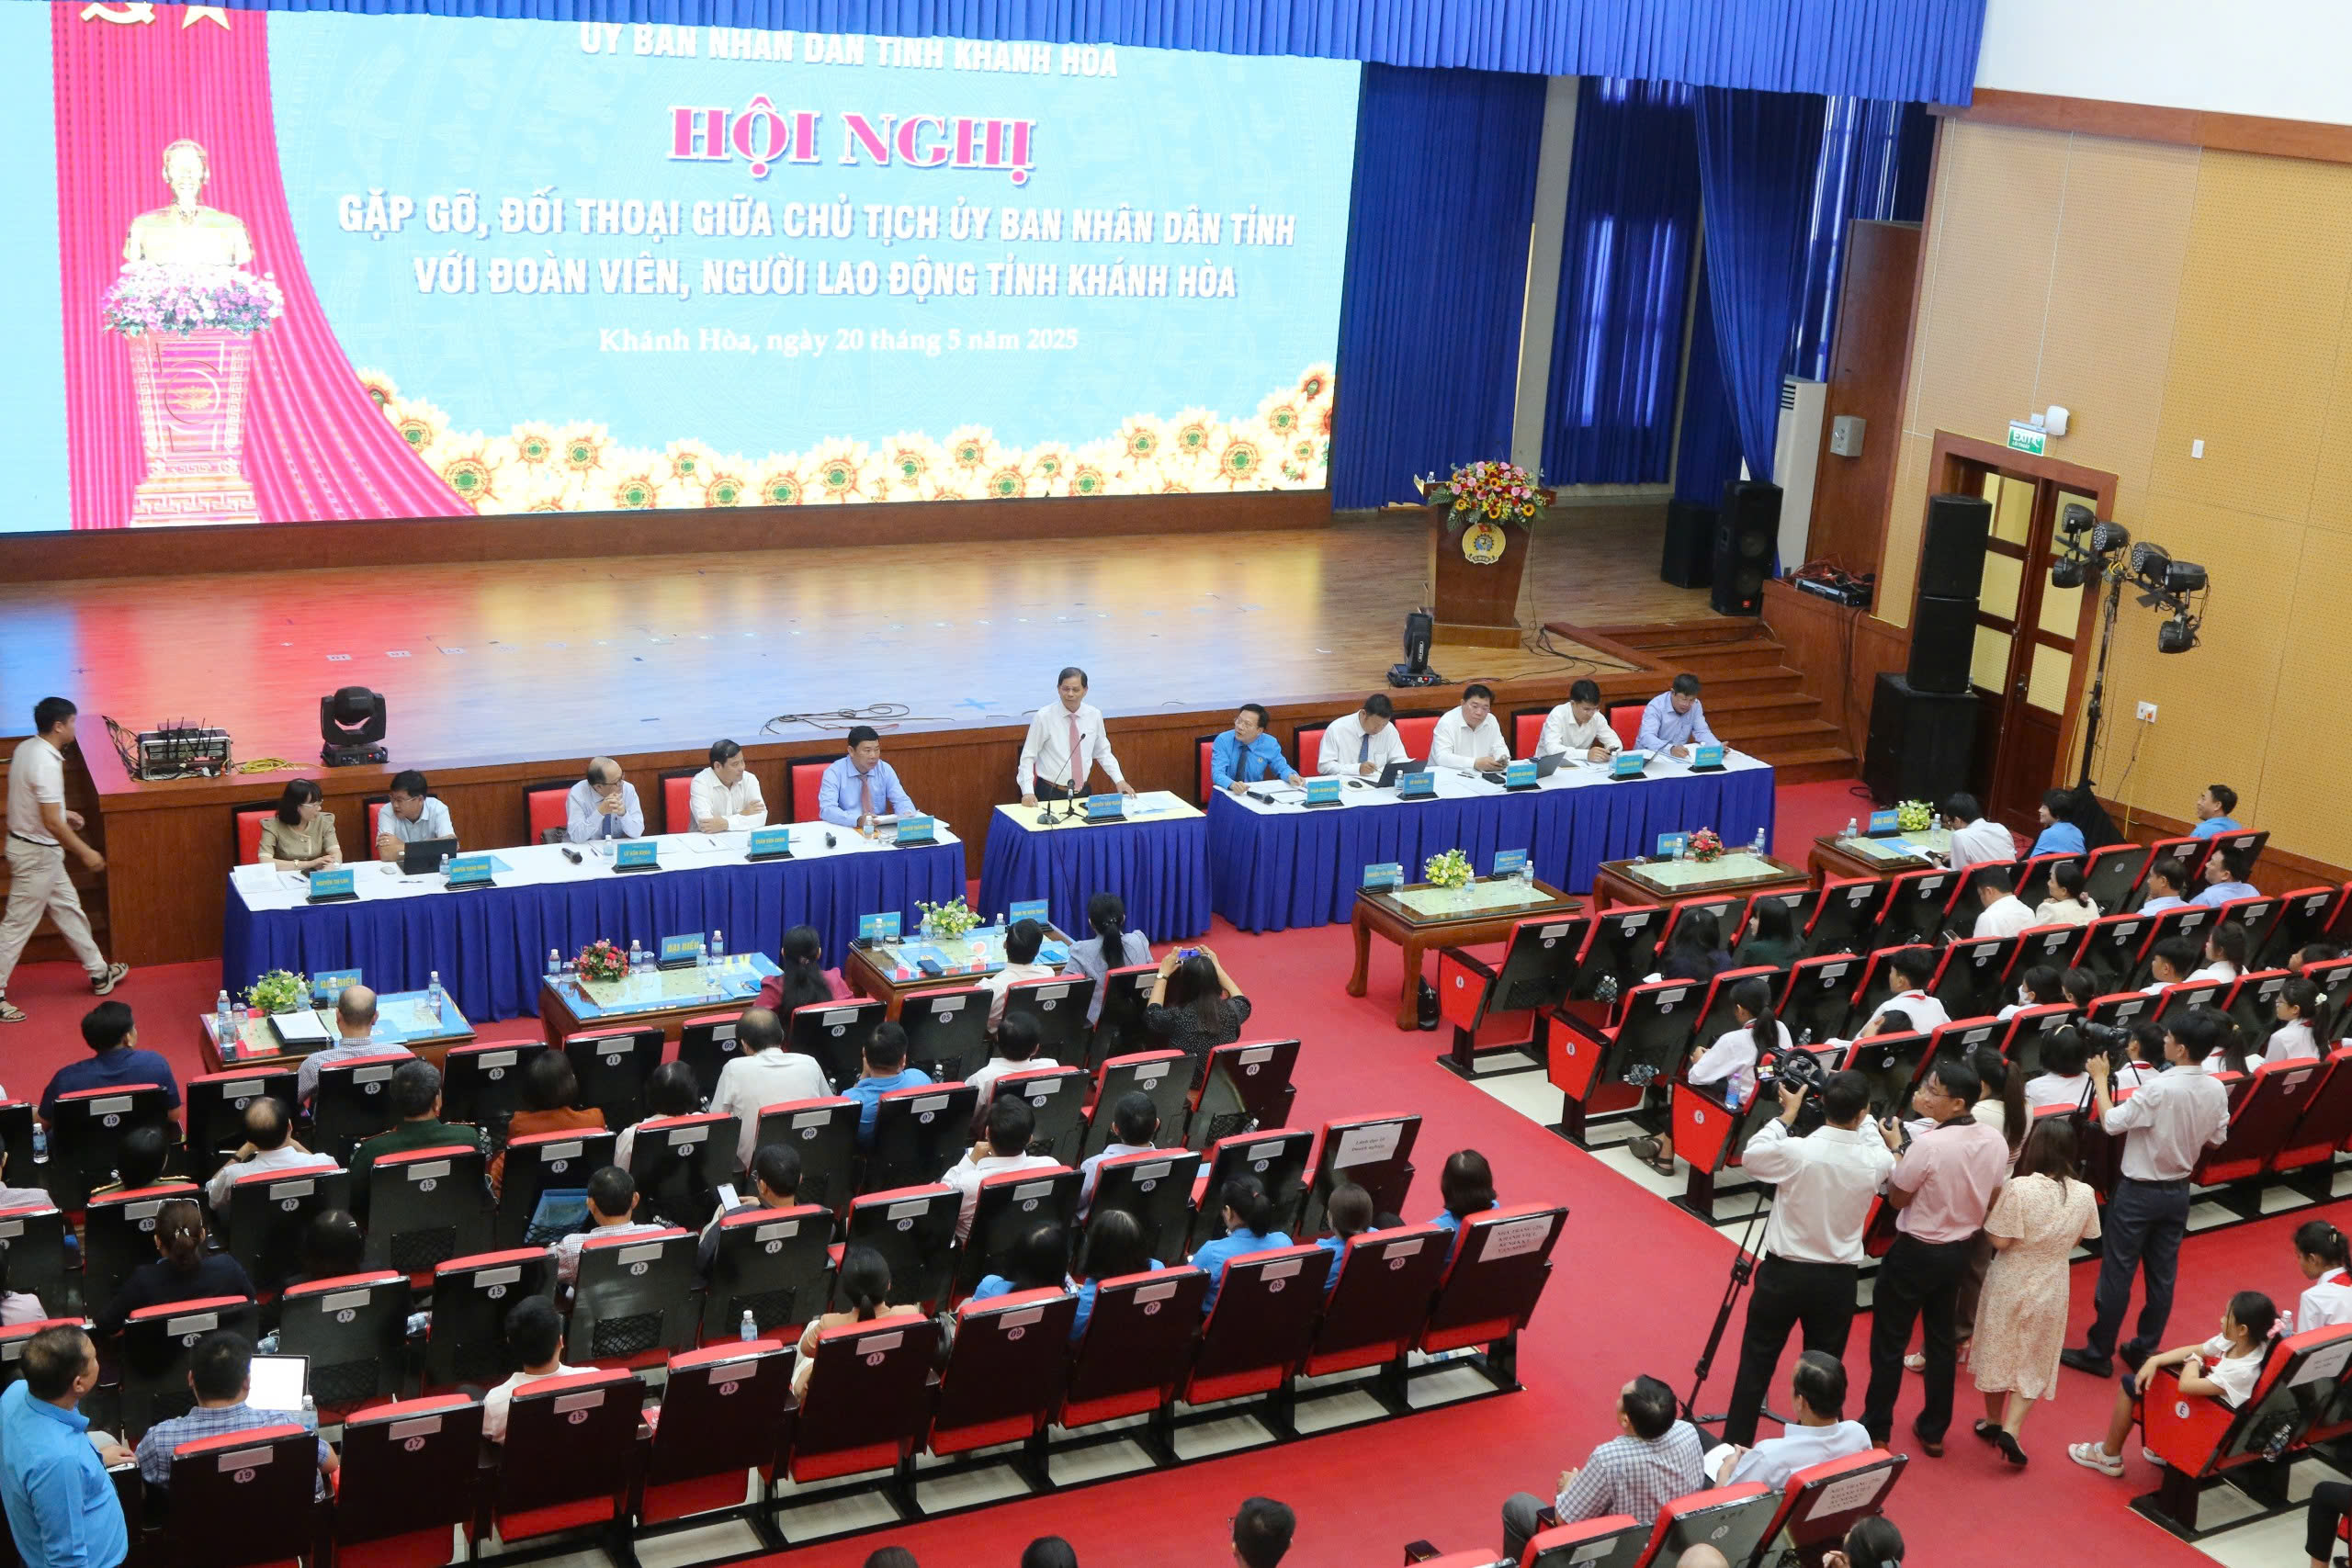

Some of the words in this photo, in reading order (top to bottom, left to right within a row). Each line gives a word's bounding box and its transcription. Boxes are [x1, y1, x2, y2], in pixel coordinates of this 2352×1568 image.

[633, 24, 696, 57] BAN
[667, 93, 821, 179] HỘI
[838, 112, 1036, 186] NGHỊ
[338, 187, 415, 241] GẶP
[425, 189, 491, 240] GỠ,
[500, 186, 565, 234] ĐỐI
[575, 198, 682, 243] THOẠI
[692, 194, 775, 237] GIỮA
[783, 194, 854, 239] CHỦ
[864, 205, 939, 247] TỊCH
[949, 197, 992, 240] ỦY
[1000, 208, 1062, 243] BAN
[1072, 202, 1155, 244] NHÂN
[1163, 204, 1221, 245] DÂN
[1230, 204, 1295, 246] TỈNH
[414, 250, 479, 295] VỚI
[488, 250, 589, 295] ĐOÀN
[598, 251, 690, 300] VIÊN,
[702, 253, 808, 296] NGƯỜI
[817, 261, 879, 296] LAO
[888, 254, 978, 303] ĐỘNG
[986, 252, 1058, 297] TỈNH
[1068, 256, 1169, 298] KHÁNH
[1177, 257, 1237, 299] HÒA
[599, 327, 690, 352] Khánh
[698, 327, 759, 355] Hòa,
[765, 328, 830, 357] ngày
[836, 328, 864, 351] 20
[870, 328, 942, 356] tháng
[947, 328, 962, 351] 5
[967, 330, 1019, 351] năm
[1026, 328, 1079, 351] 2025
[2013, 431, 2031, 445] EXIT
